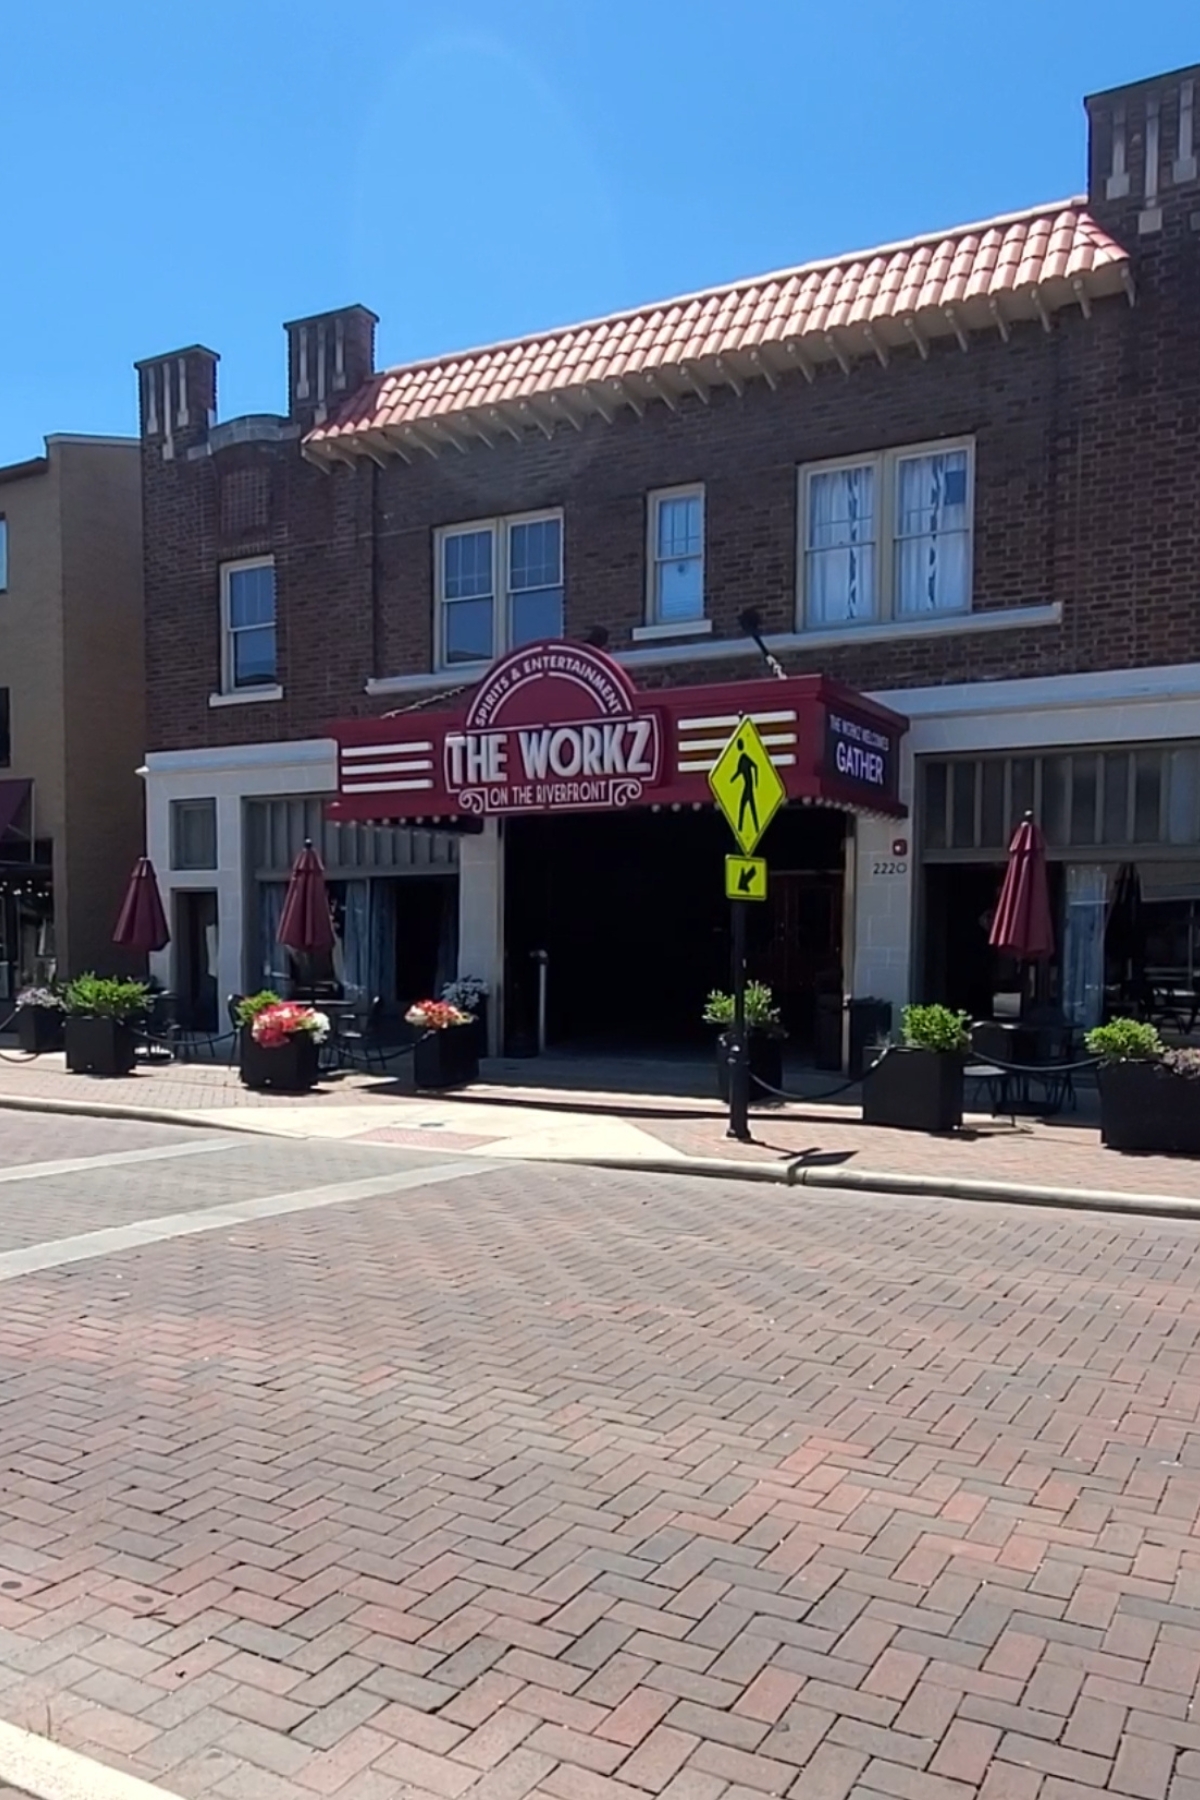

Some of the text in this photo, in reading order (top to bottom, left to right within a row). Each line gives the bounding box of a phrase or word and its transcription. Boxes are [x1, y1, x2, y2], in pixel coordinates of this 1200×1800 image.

[475, 655, 623, 727] SPIRITS & ENTERTAINMENT
[446, 721, 651, 785] THE WORKZ
[836, 741, 884, 785] GATHER
[490, 781, 607, 806] ON THE RIVERFRONT
[872, 862, 908, 875] 2220
